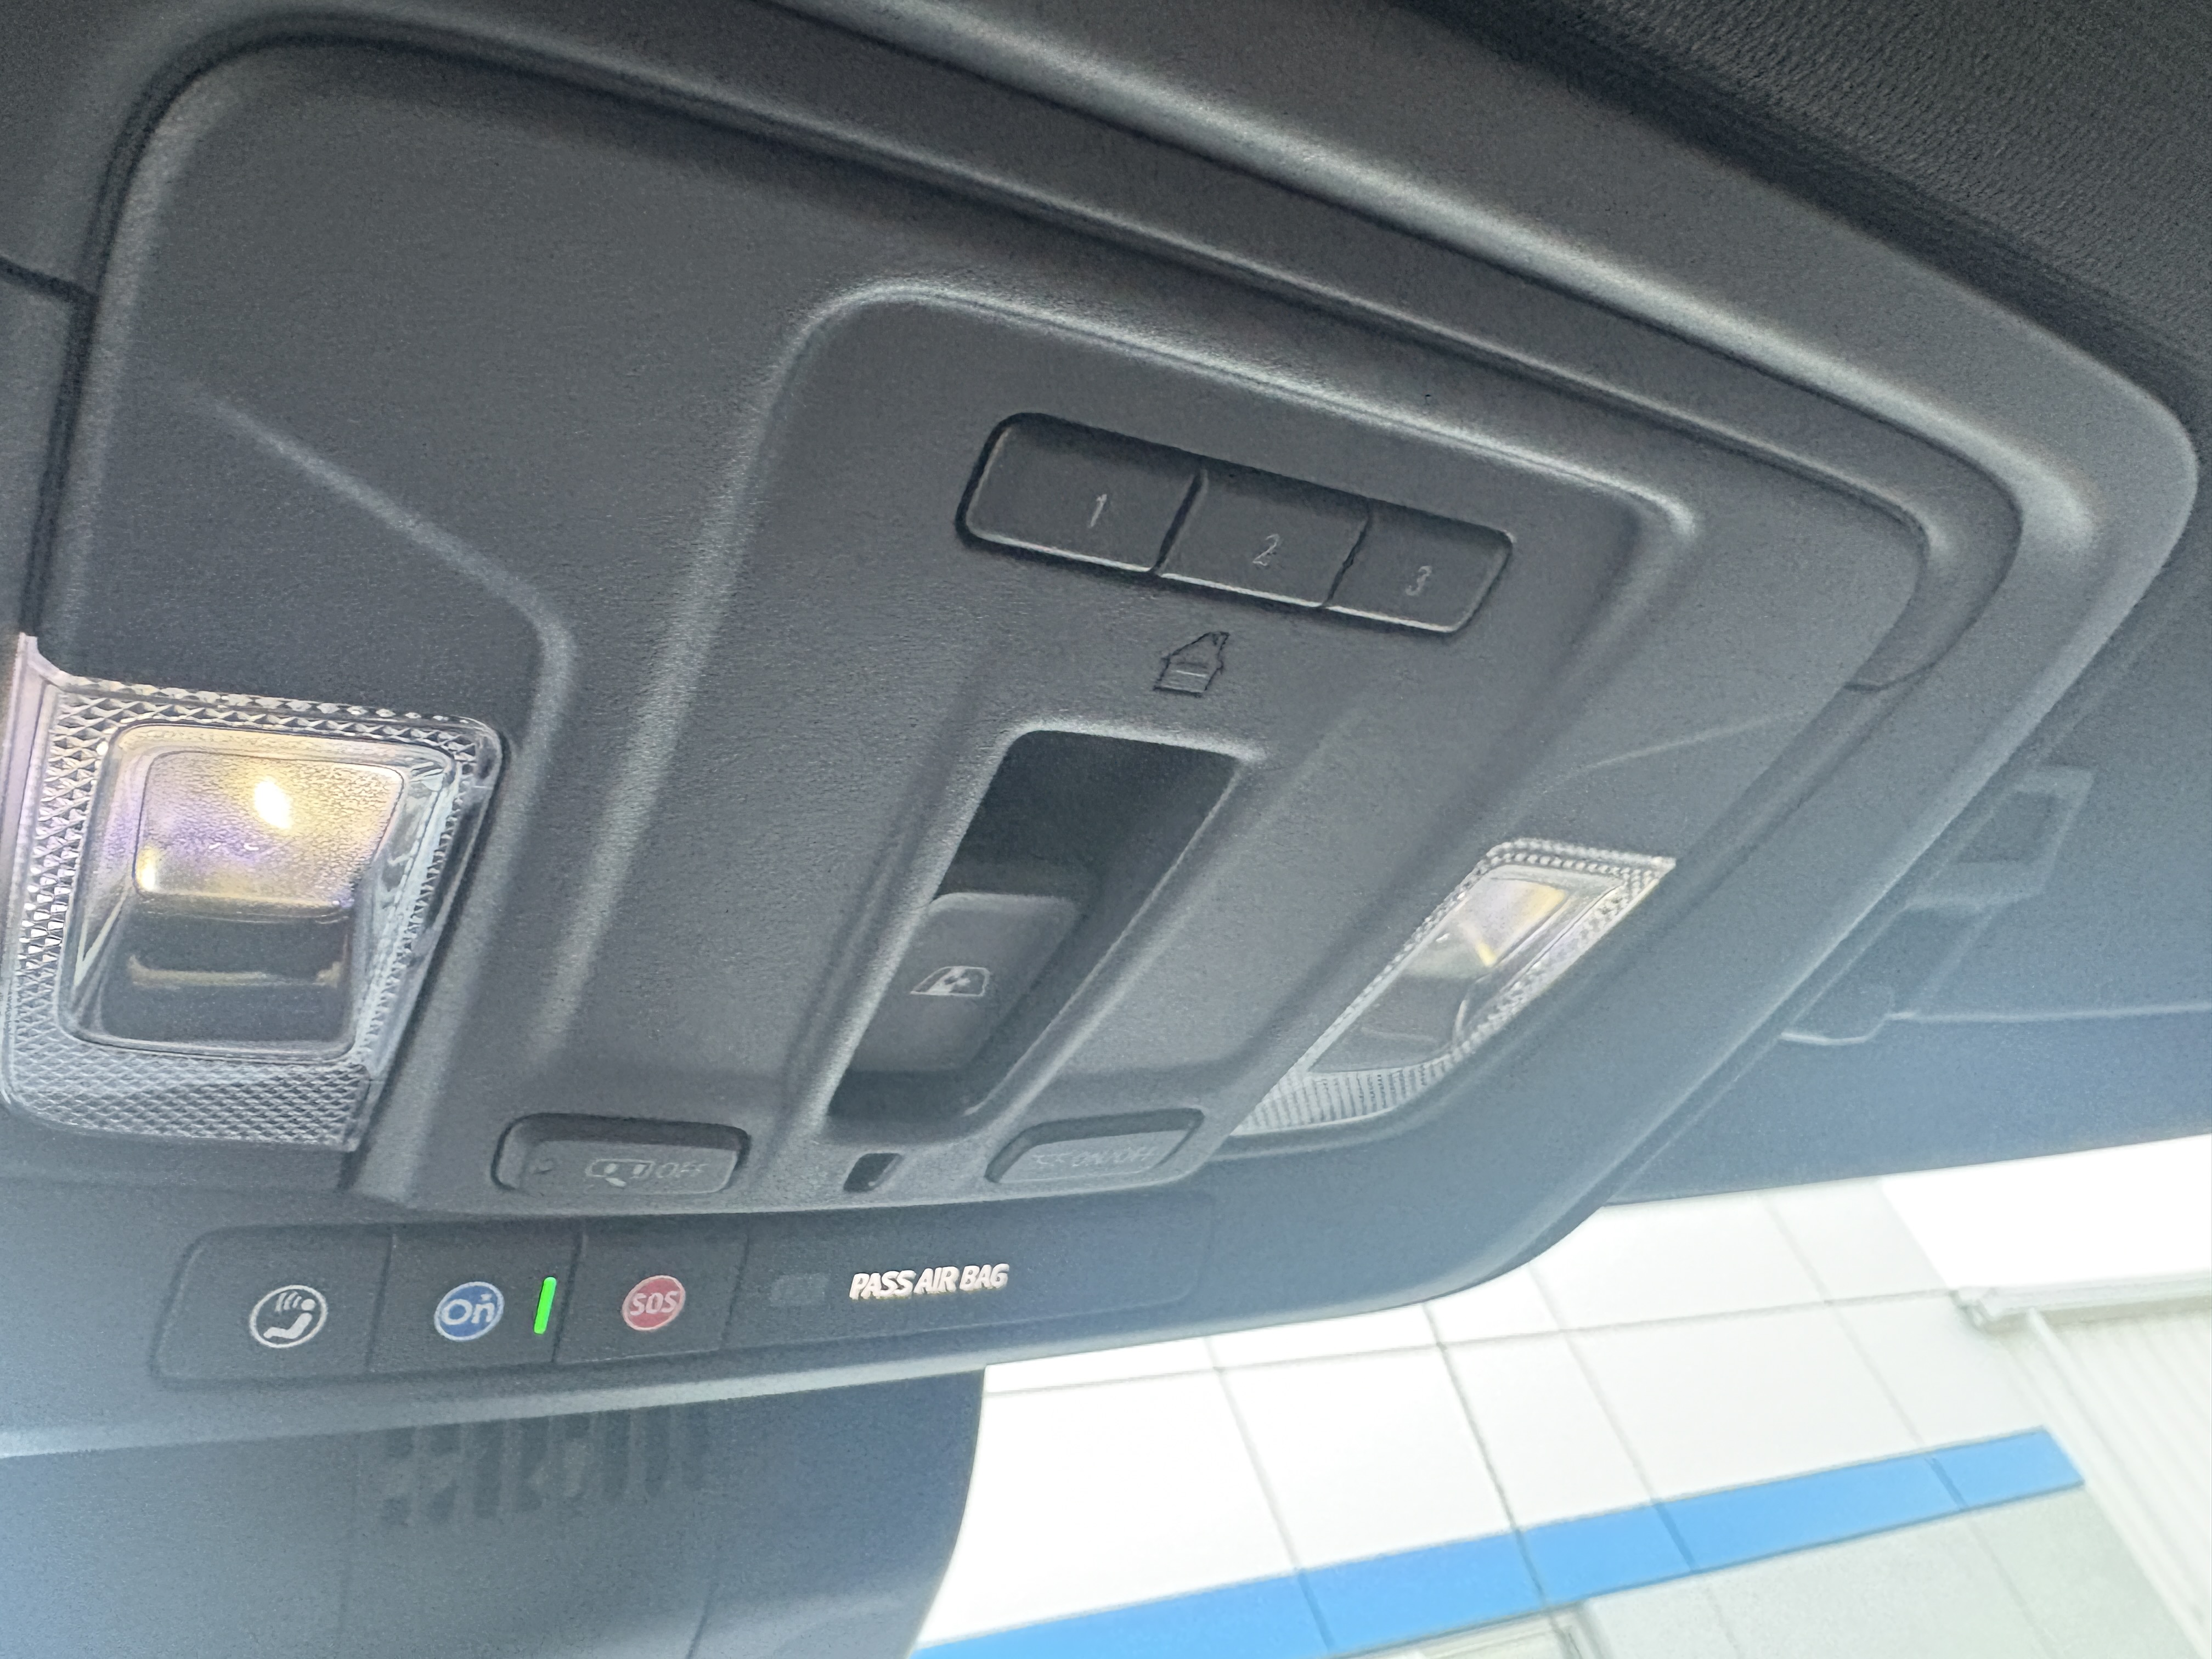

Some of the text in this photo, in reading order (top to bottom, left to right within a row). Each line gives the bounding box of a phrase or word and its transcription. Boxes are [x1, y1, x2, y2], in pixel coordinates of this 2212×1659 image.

[1089, 494, 1107, 527] 1
[1252, 534, 1280, 566] 2
[1405, 565, 1432, 596] 3
[850, 1263, 1009, 1300] PASS AIR BAG
[630, 1291, 678, 1316] SOS
